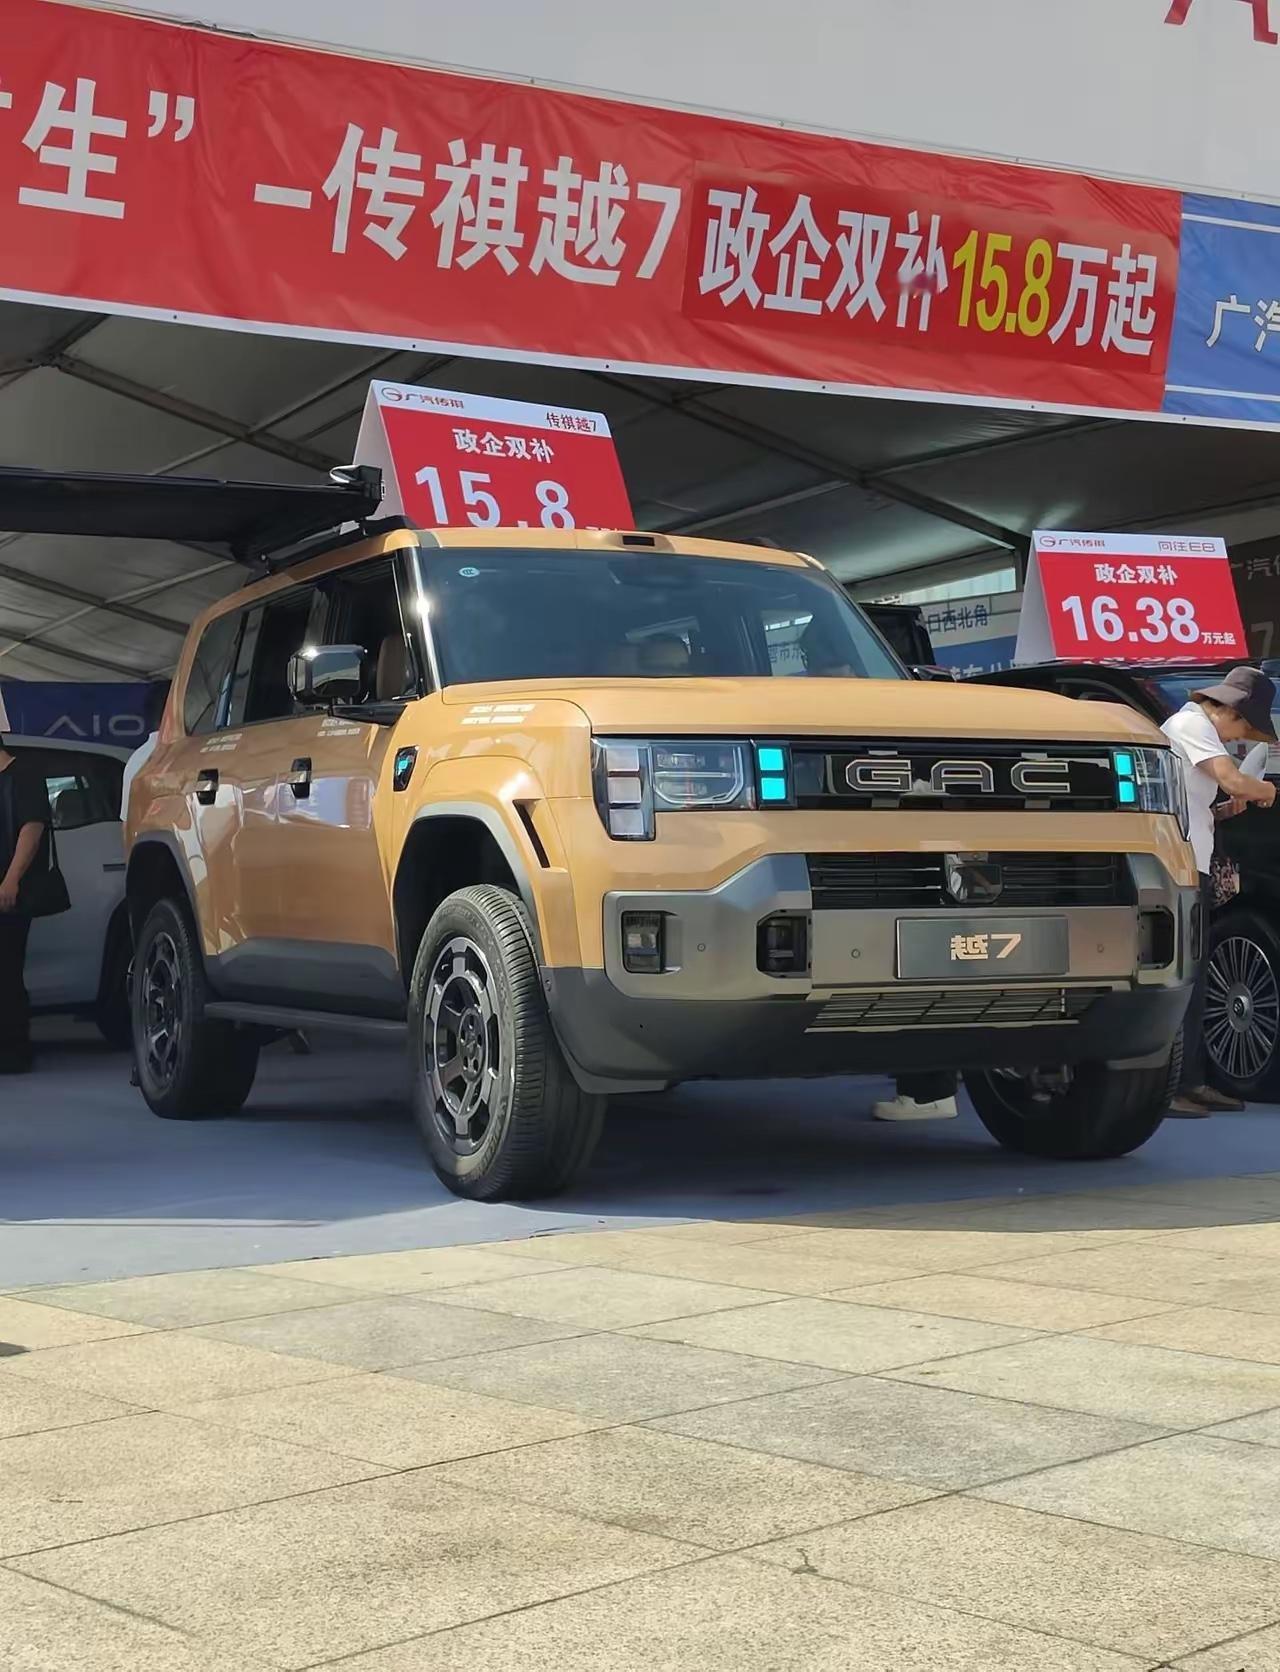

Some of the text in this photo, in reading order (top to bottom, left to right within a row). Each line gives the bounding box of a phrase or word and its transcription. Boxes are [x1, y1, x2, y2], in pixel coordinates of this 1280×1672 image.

[0, 78, 195, 219] 生”
[698, 186, 1158, 356] 政企双补15.8万起
[546, 412, 597, 433] 传祺越7
[452, 428, 555, 463] 政企双补
[1093, 563, 1178, 586] 政企双补
[1061, 595, 1200, 644] 16.38
[845, 759, 1071, 793] GAC
[950, 933, 1022, 961] 越7
